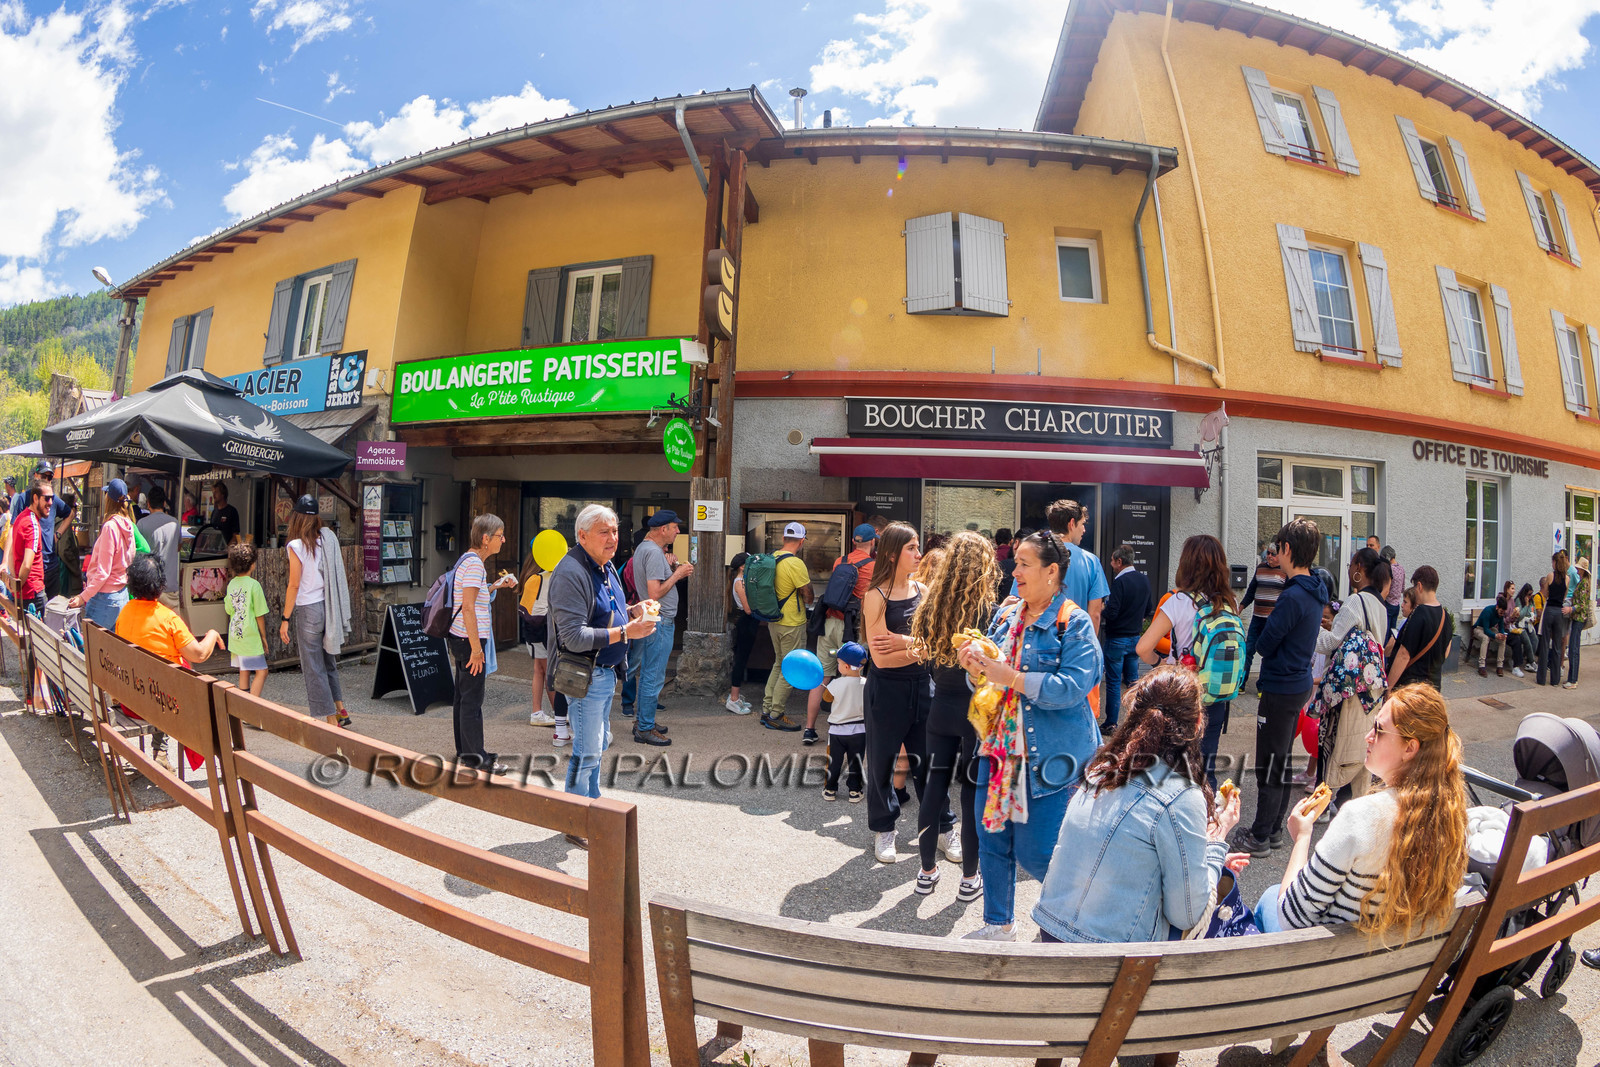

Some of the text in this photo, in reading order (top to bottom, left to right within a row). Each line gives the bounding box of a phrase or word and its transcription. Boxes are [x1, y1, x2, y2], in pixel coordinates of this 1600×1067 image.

[328, 357, 341, 393] BEN
[400, 350, 678, 394] BOULANGERIE PATISSERIE
[326, 390, 360, 407] JERRY'S
[470, 387, 576, 409] La P'tite Rustique
[864, 403, 1163, 438] BOUCHER CHARCUTIER
[225, 440, 281, 461] GRIMBERGEN
[357, 456, 404, 466] Immobilière
[367, 446, 396, 456] Agence
[1412, 440, 1549, 478] OFFICE DE TOURISME
